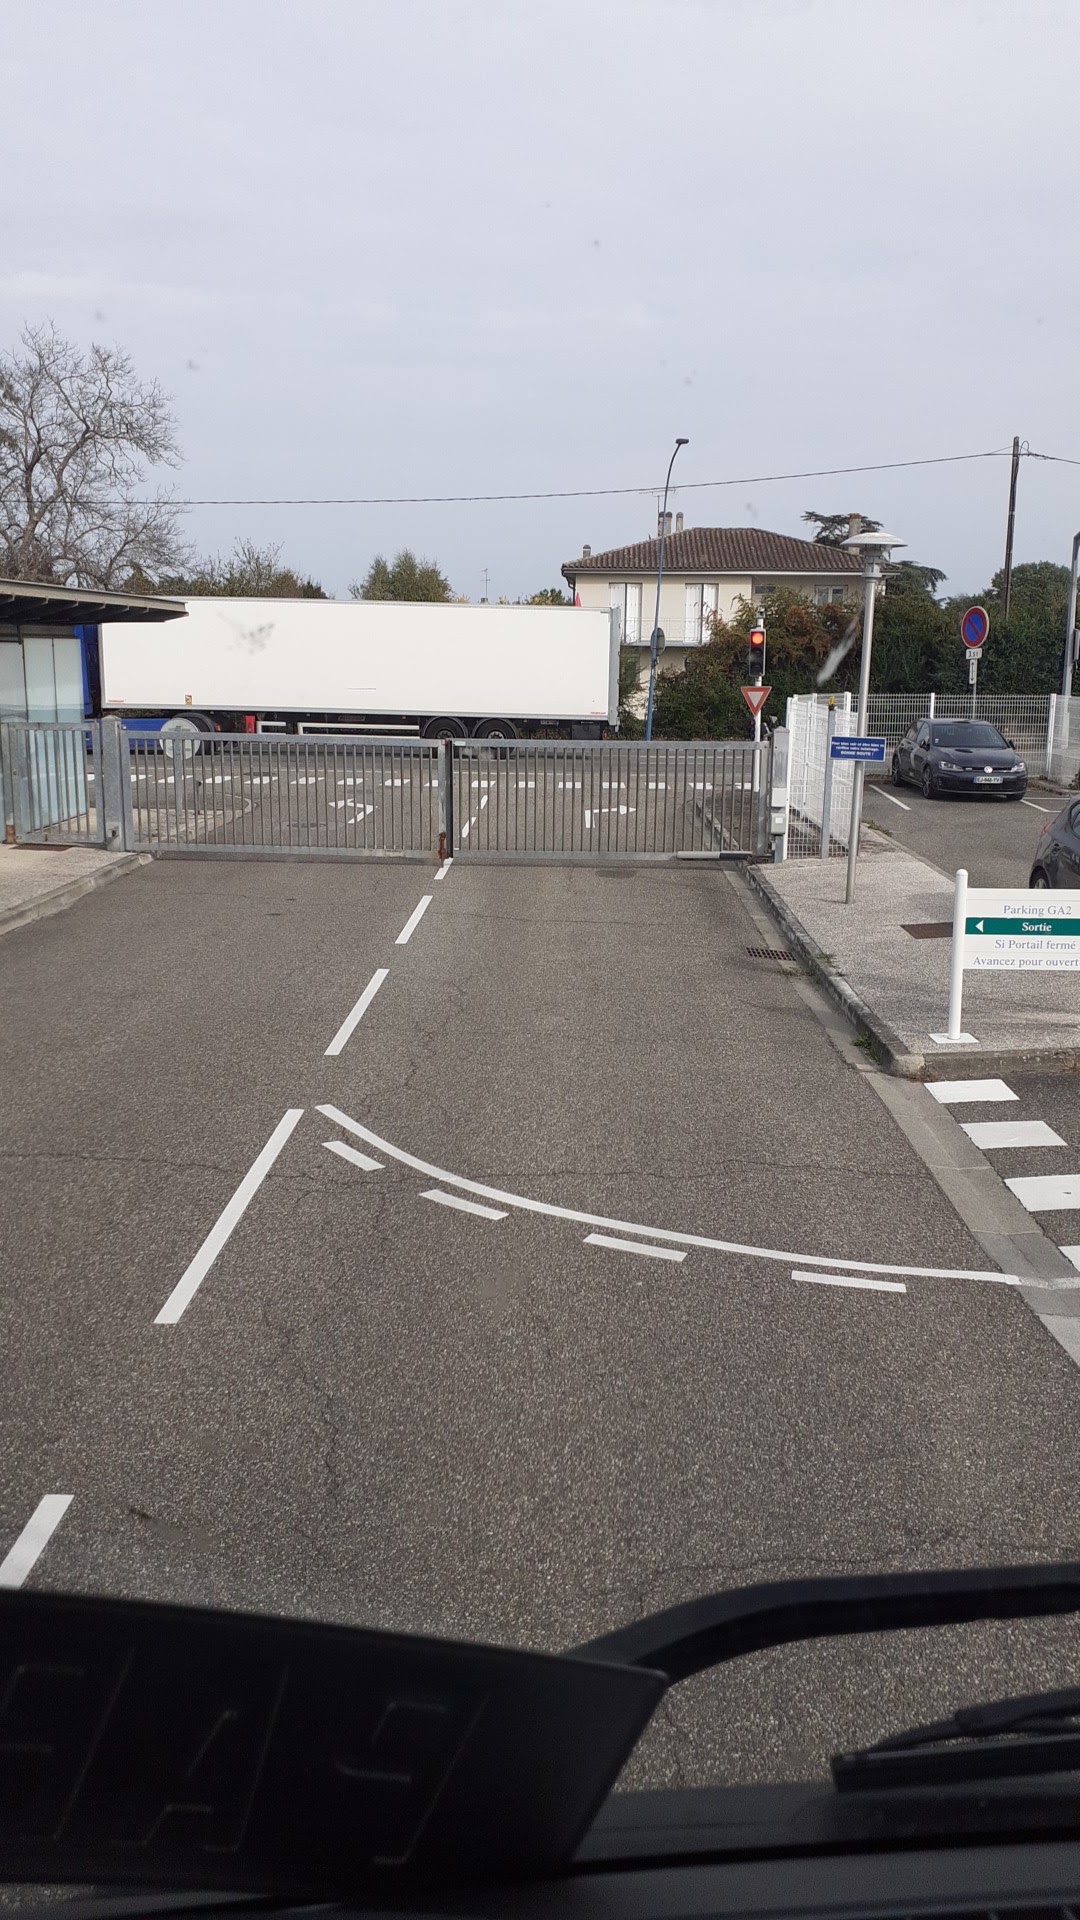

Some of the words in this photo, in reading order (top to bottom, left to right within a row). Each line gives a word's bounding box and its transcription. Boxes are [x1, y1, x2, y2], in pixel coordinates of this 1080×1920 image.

[1003, 905, 1044, 916] Parking
[1047, 906, 1072, 915] GA2
[1022, 922, 1052, 932] Sortie
[995, 940, 1005, 948] Si
[1008, 940, 1043, 949] Portail
[1046, 940, 1076, 950] fermé
[973, 956, 1016, 966] Avancez
[1018, 959, 1043, 968] pour
